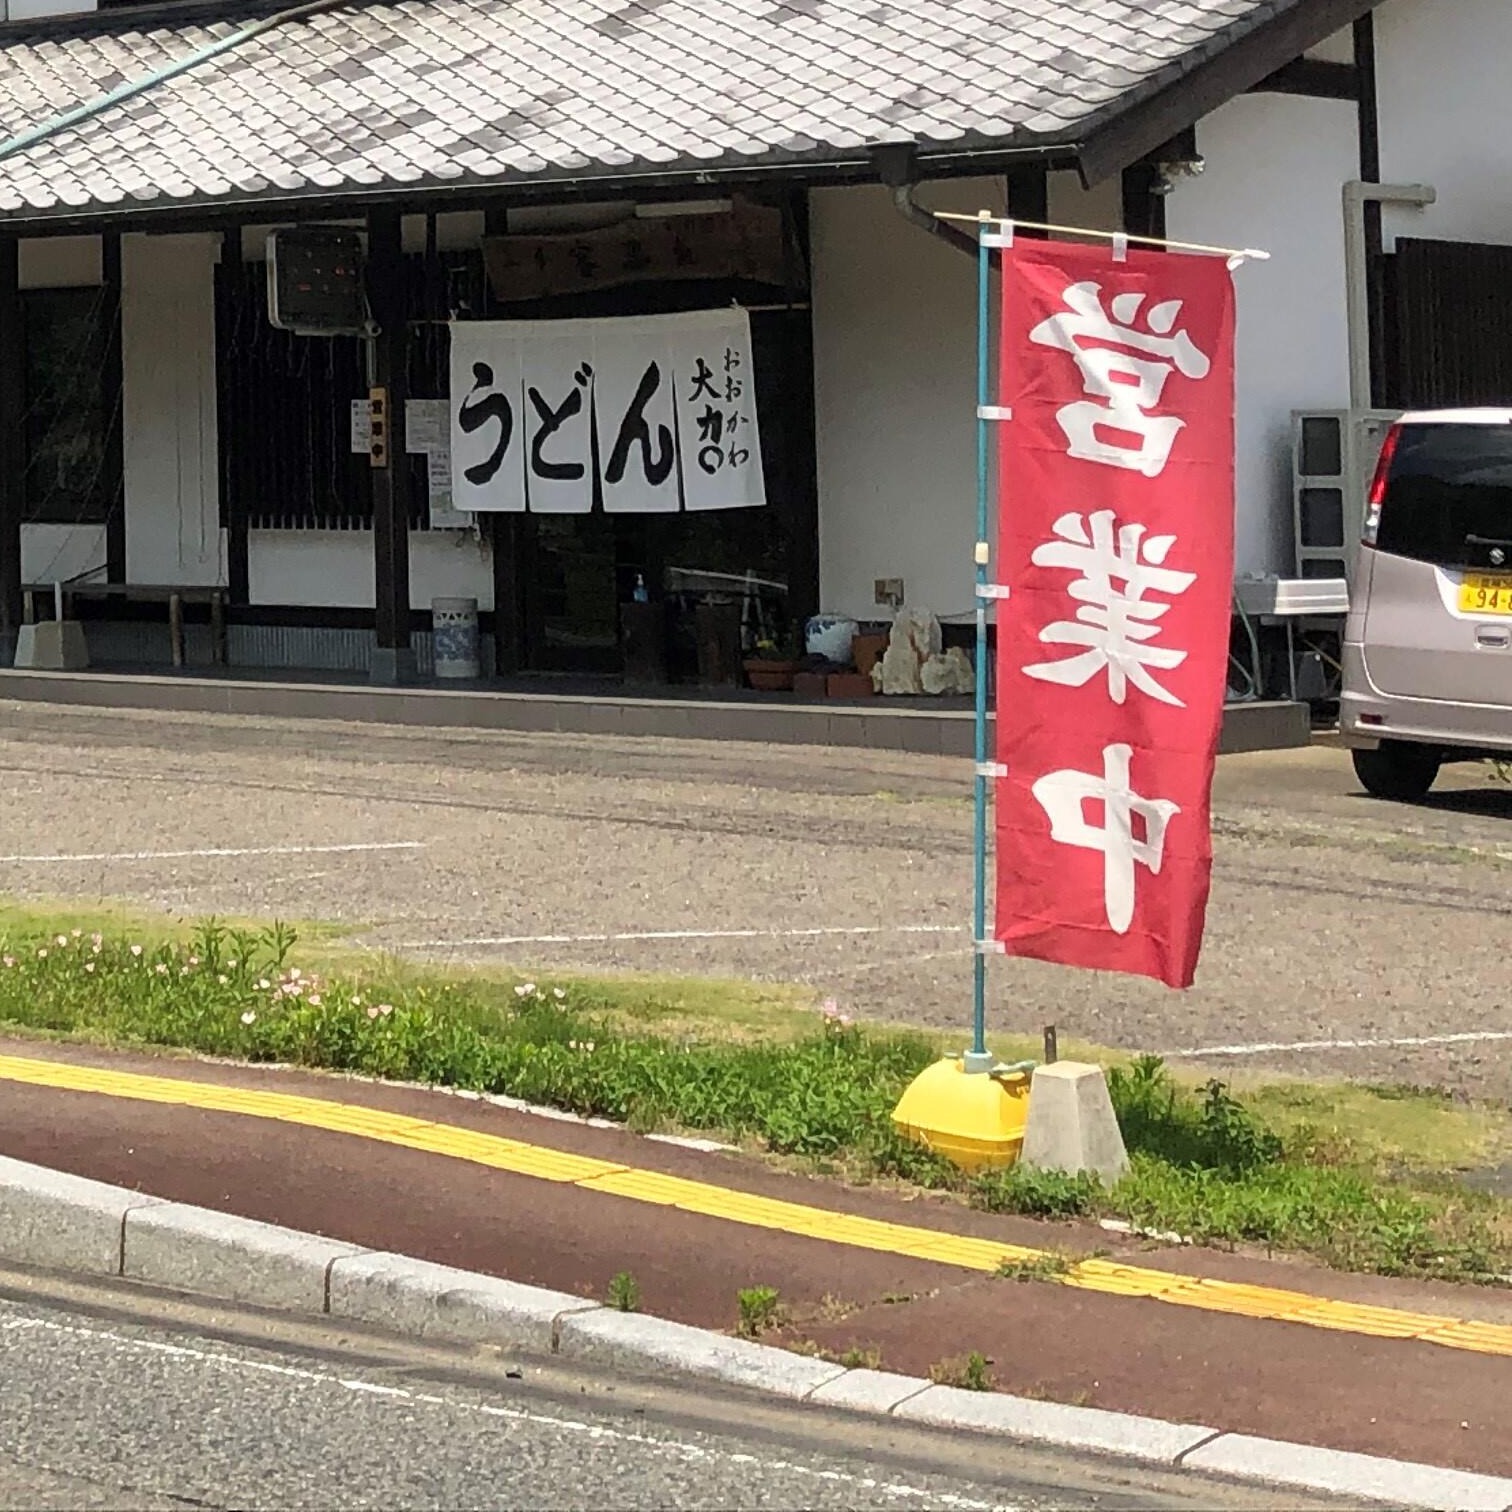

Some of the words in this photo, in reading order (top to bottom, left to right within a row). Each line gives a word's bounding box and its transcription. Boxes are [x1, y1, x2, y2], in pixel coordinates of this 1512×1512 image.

[458, 360, 675, 486] うどん
[724, 347, 750, 468] おおかわ
[1021, 281, 1211, 934] 営業中
